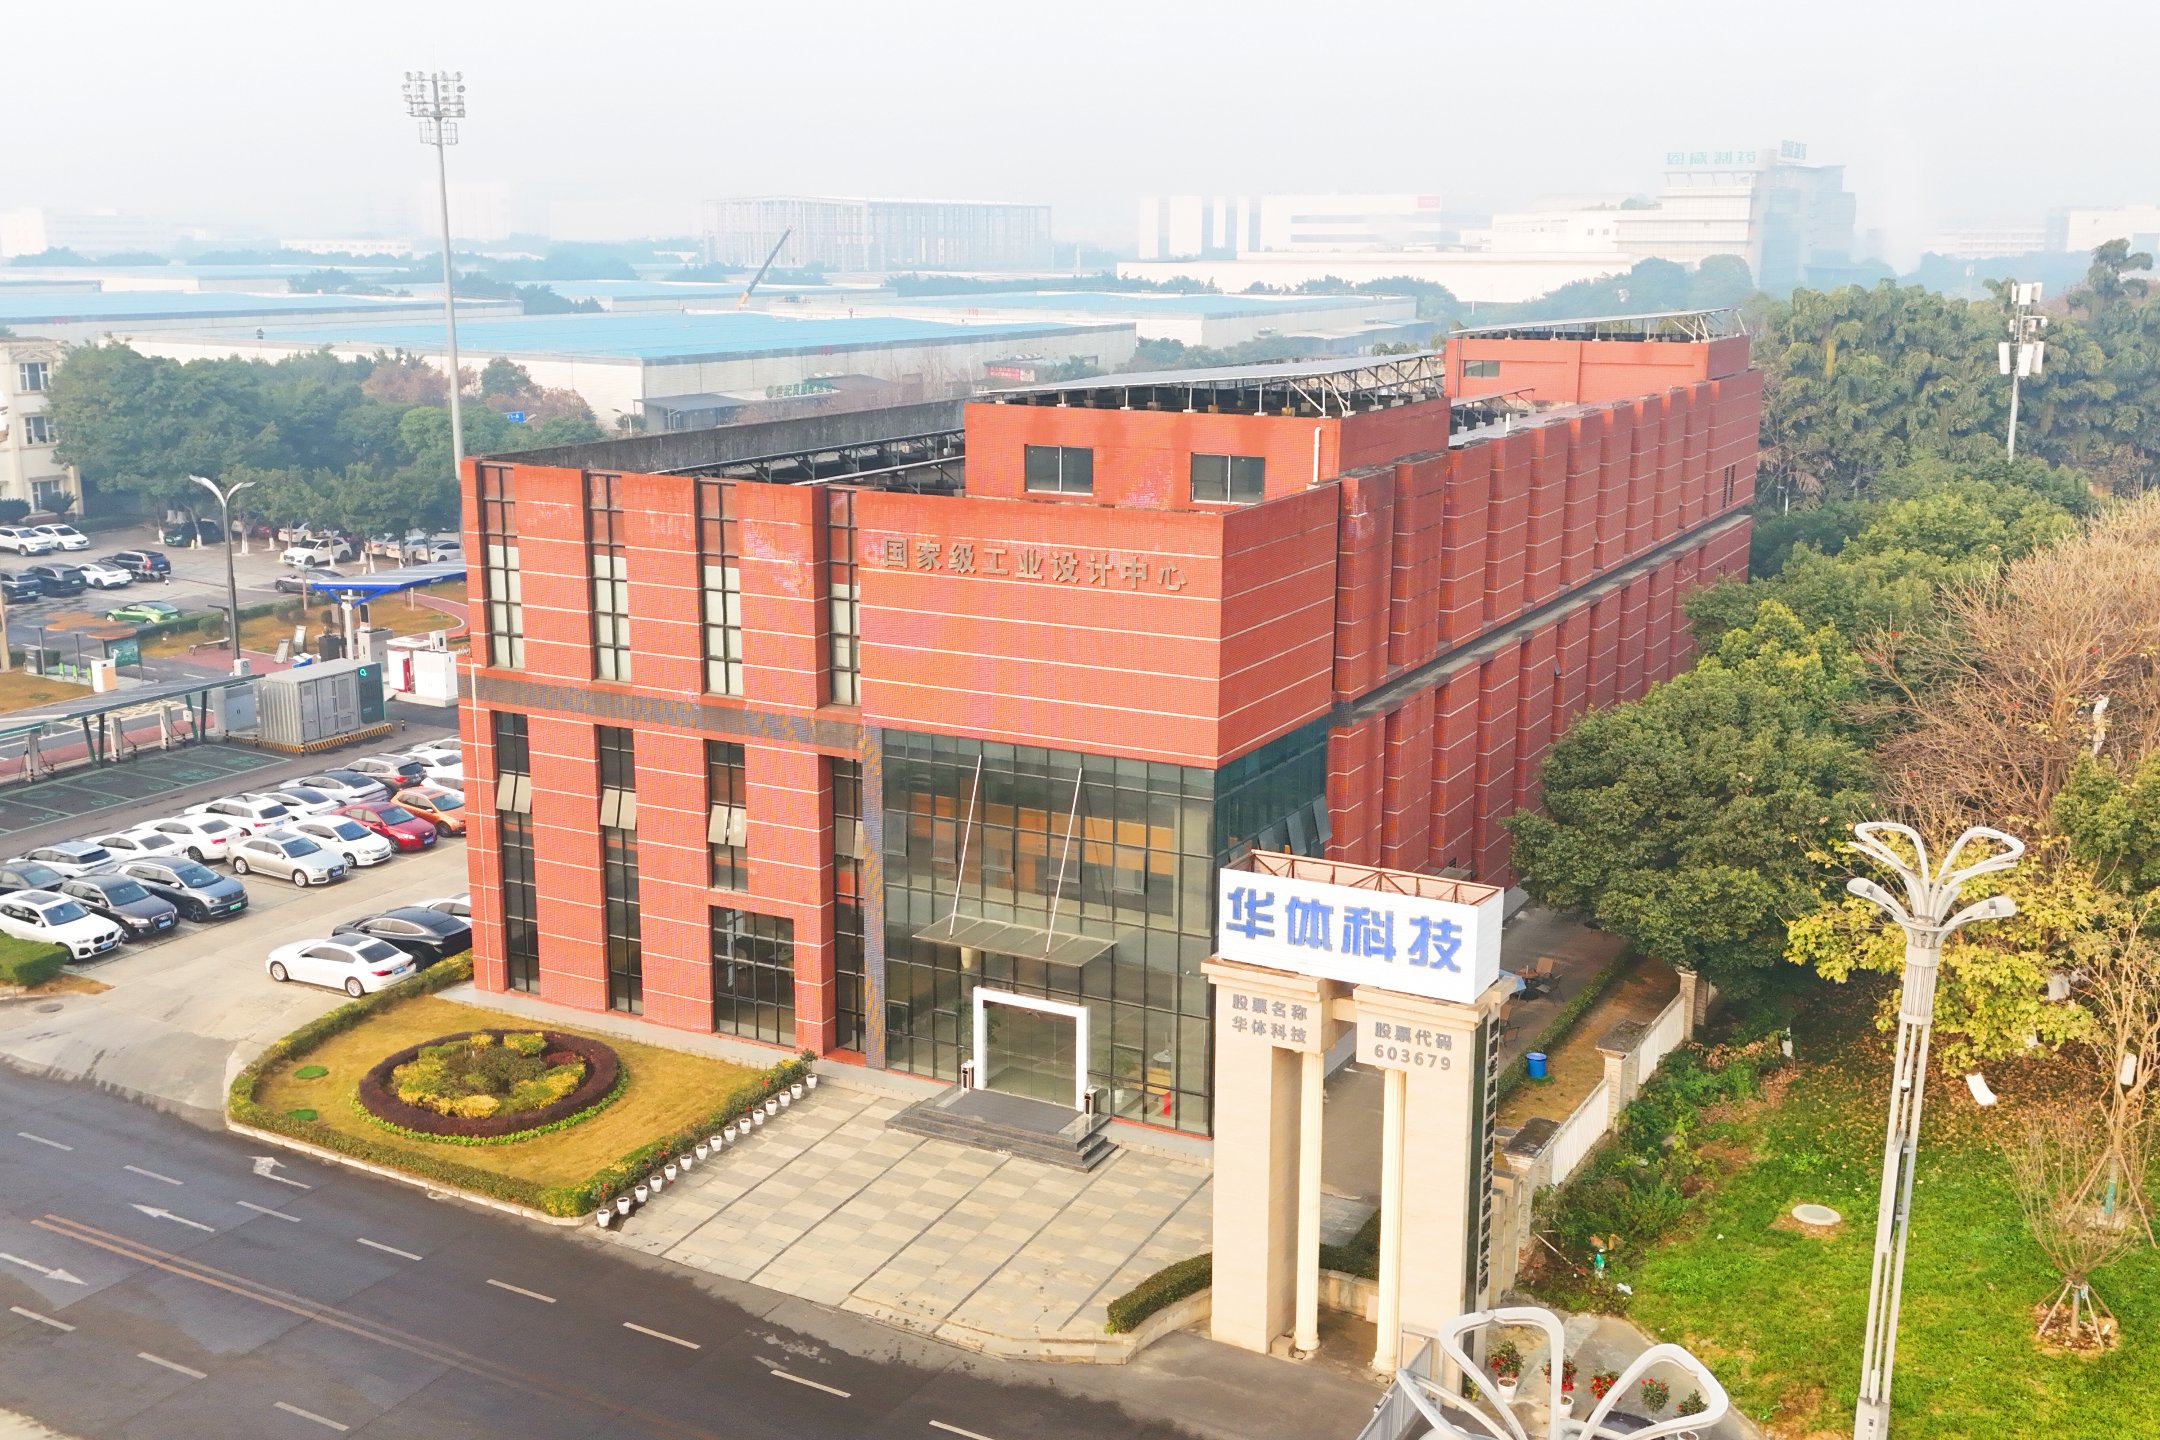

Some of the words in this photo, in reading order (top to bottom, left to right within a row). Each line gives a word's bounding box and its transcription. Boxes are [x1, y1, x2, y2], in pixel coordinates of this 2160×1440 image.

[882, 536, 1188, 592] 国家级工业设计中心
[1225, 886, 1463, 974] 华体科技
[1232, 993, 1308, 1021] 股票名称
[1232, 1015, 1308, 1045] 华体科技
[1374, 1021, 1453, 1052] 股票代码
[1373, 1044, 1452, 1071] 603679
